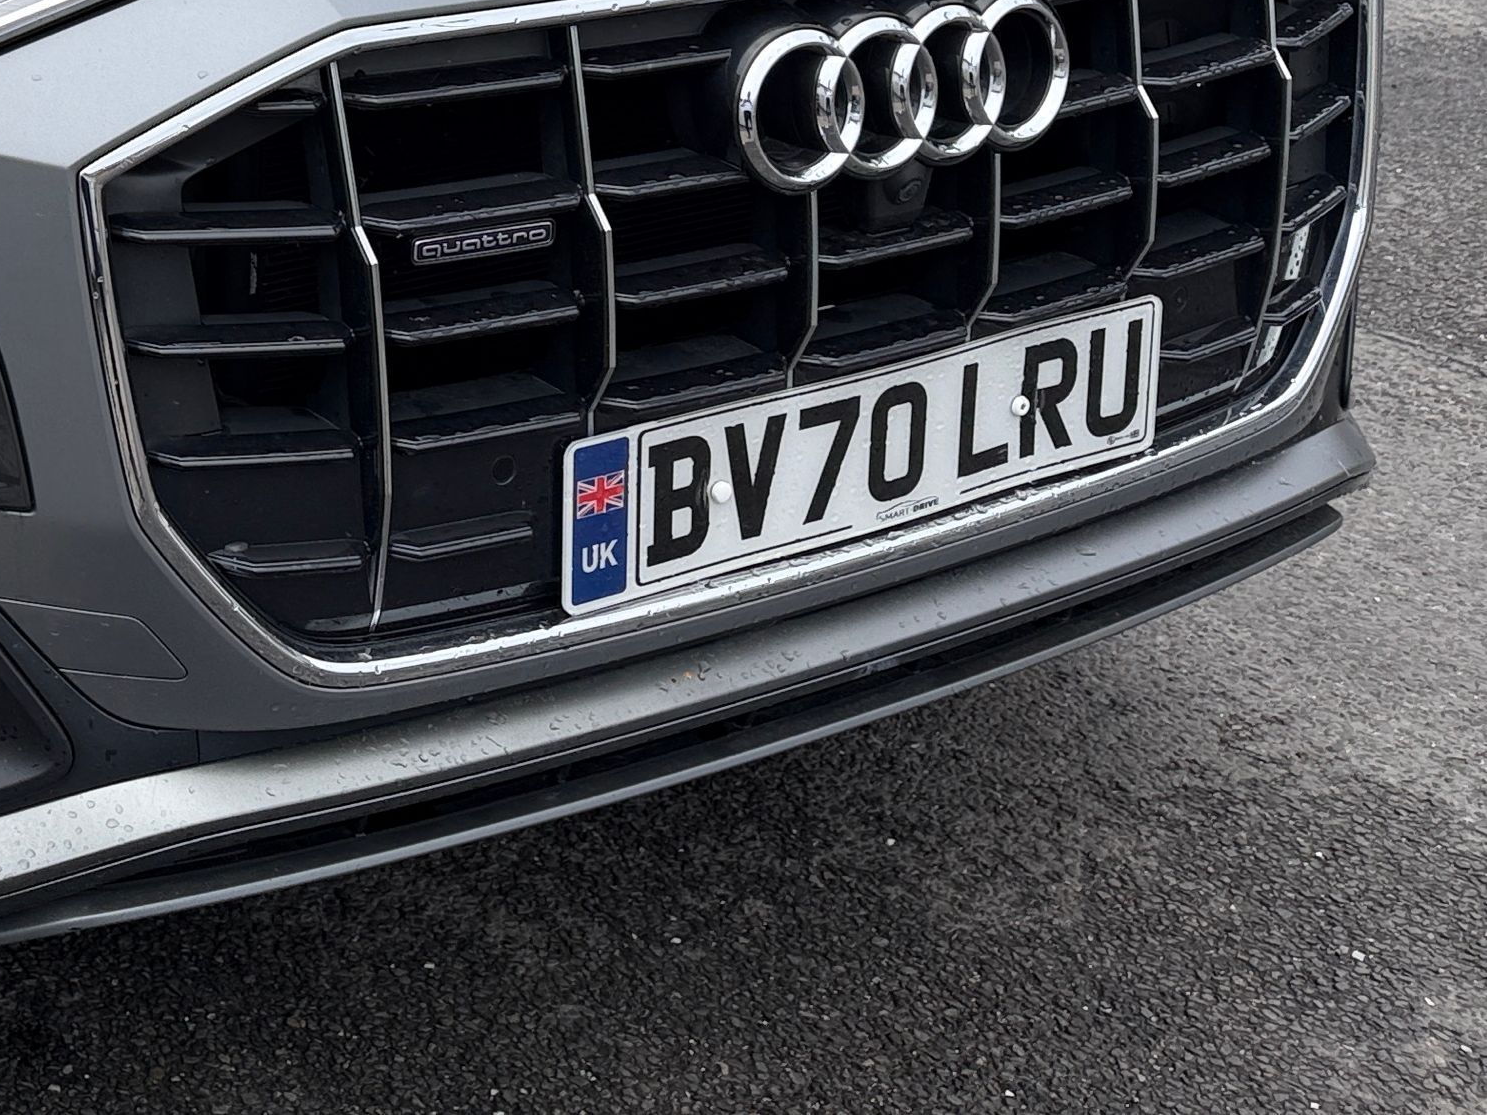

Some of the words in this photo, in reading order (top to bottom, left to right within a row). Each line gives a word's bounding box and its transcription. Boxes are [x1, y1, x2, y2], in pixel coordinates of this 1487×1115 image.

[422, 228, 547, 258] quattro
[646, 381, 928, 568] BV70
[956, 318, 1144, 478] LRU
[879, 507, 910, 522] SMART
[913, 498, 940, 513] DRIVE
[581, 538, 619, 575] UK
